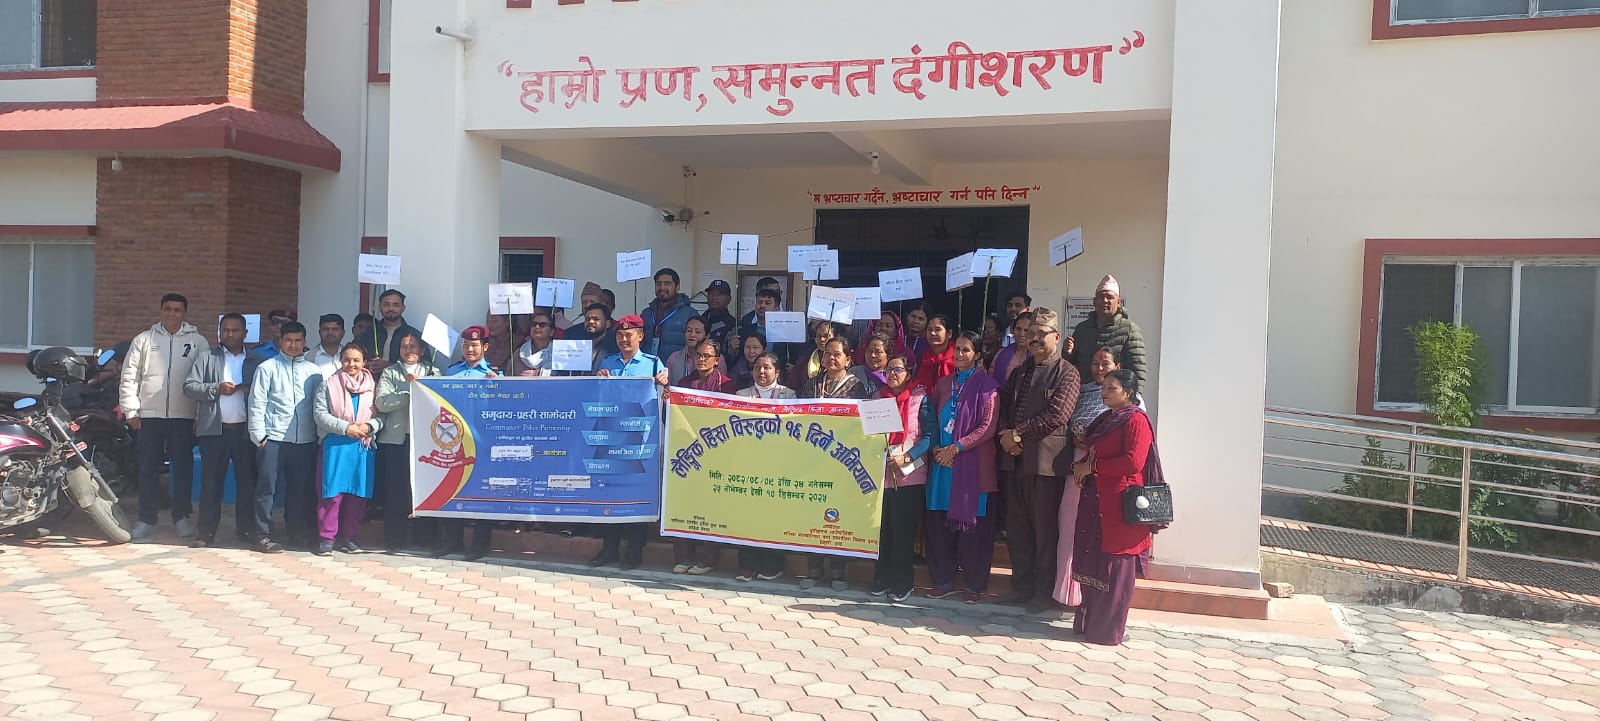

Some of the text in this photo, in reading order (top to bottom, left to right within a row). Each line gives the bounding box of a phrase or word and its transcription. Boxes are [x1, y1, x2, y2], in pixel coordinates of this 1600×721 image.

[711, 58, 885, 117] समुन्नत
[949, 186, 971, 202] गर्न
[975, 186, 995, 201] पनि
[784, 420, 804, 443] १६
[805, 421, 835, 452] दिने
[829, 440, 878, 496] अभियान
